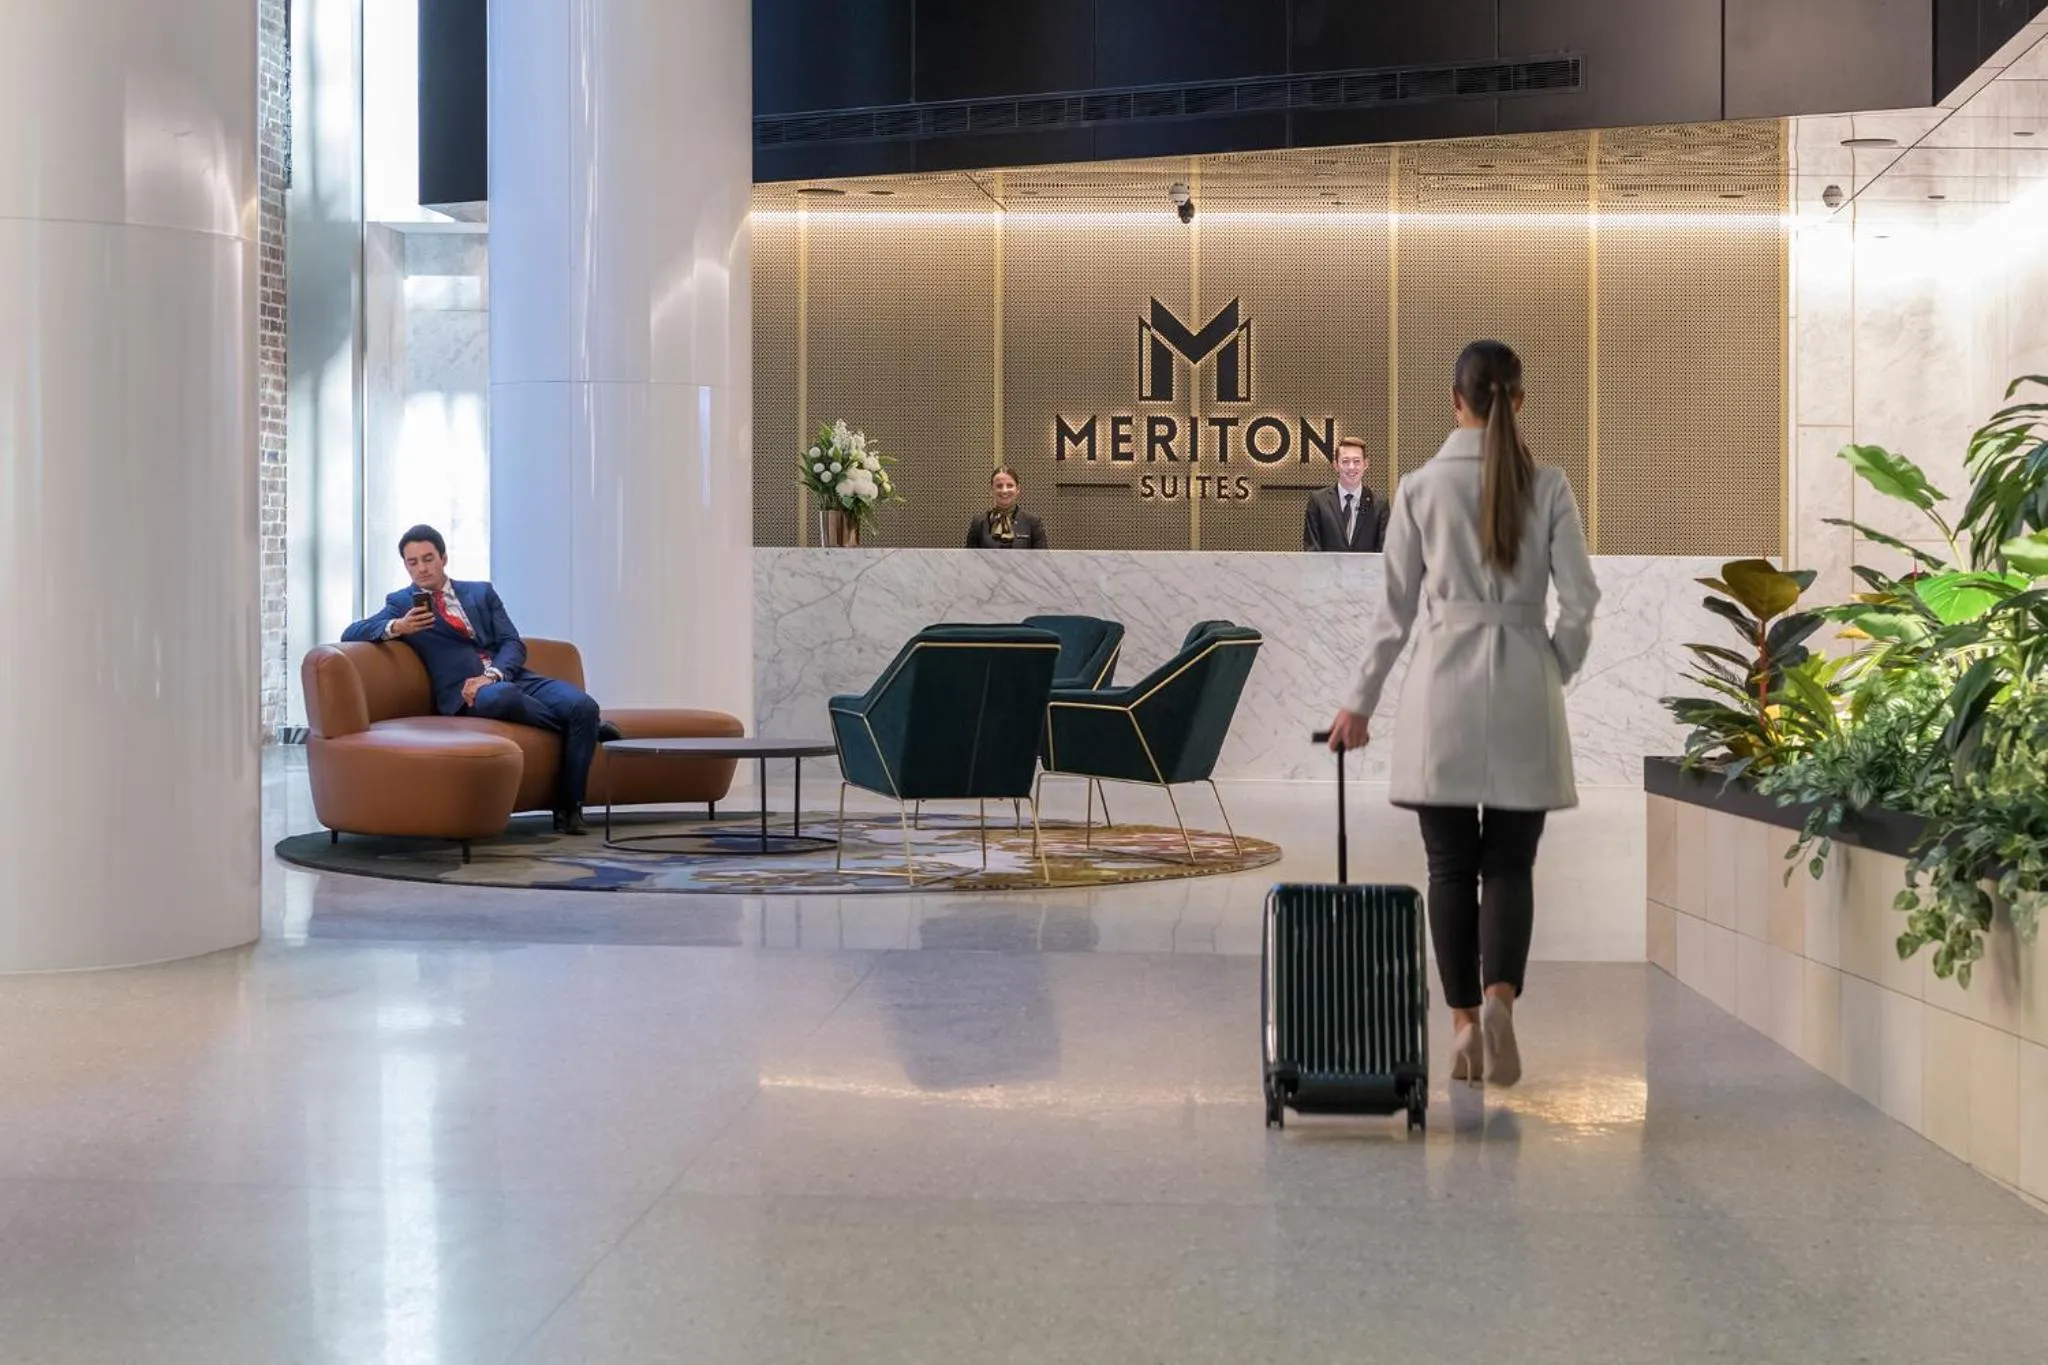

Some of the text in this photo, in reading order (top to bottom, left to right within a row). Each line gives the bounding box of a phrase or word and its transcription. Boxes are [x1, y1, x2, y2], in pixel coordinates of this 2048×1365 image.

[1139, 296, 1251, 402] M
[1056, 414, 1334, 464] MERITON
[1142, 475, 1250, 499] SUITES
